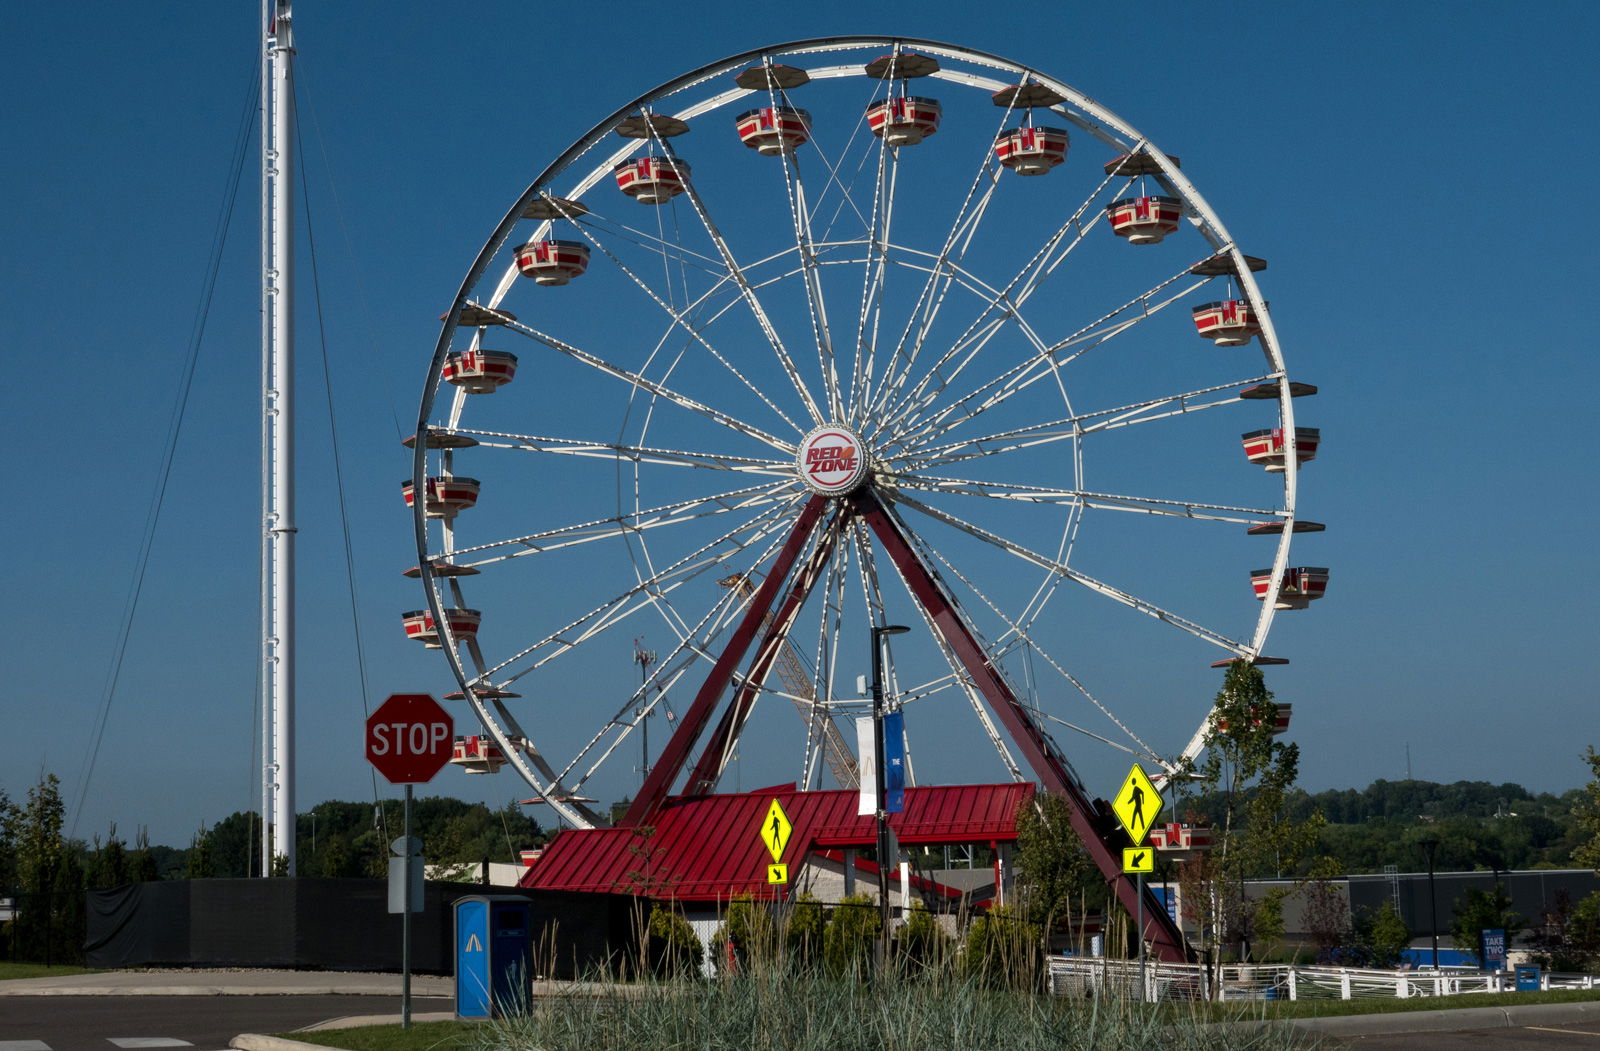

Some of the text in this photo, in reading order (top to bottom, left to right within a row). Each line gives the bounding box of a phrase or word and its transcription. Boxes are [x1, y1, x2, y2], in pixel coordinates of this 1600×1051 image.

[806, 446, 843, 465] RED
[808, 458, 859, 473] ZONE
[371, 722, 449, 756] STOP
[1485, 937, 1504, 945] TAKE
[1485, 946, 1504, 954] TWO
